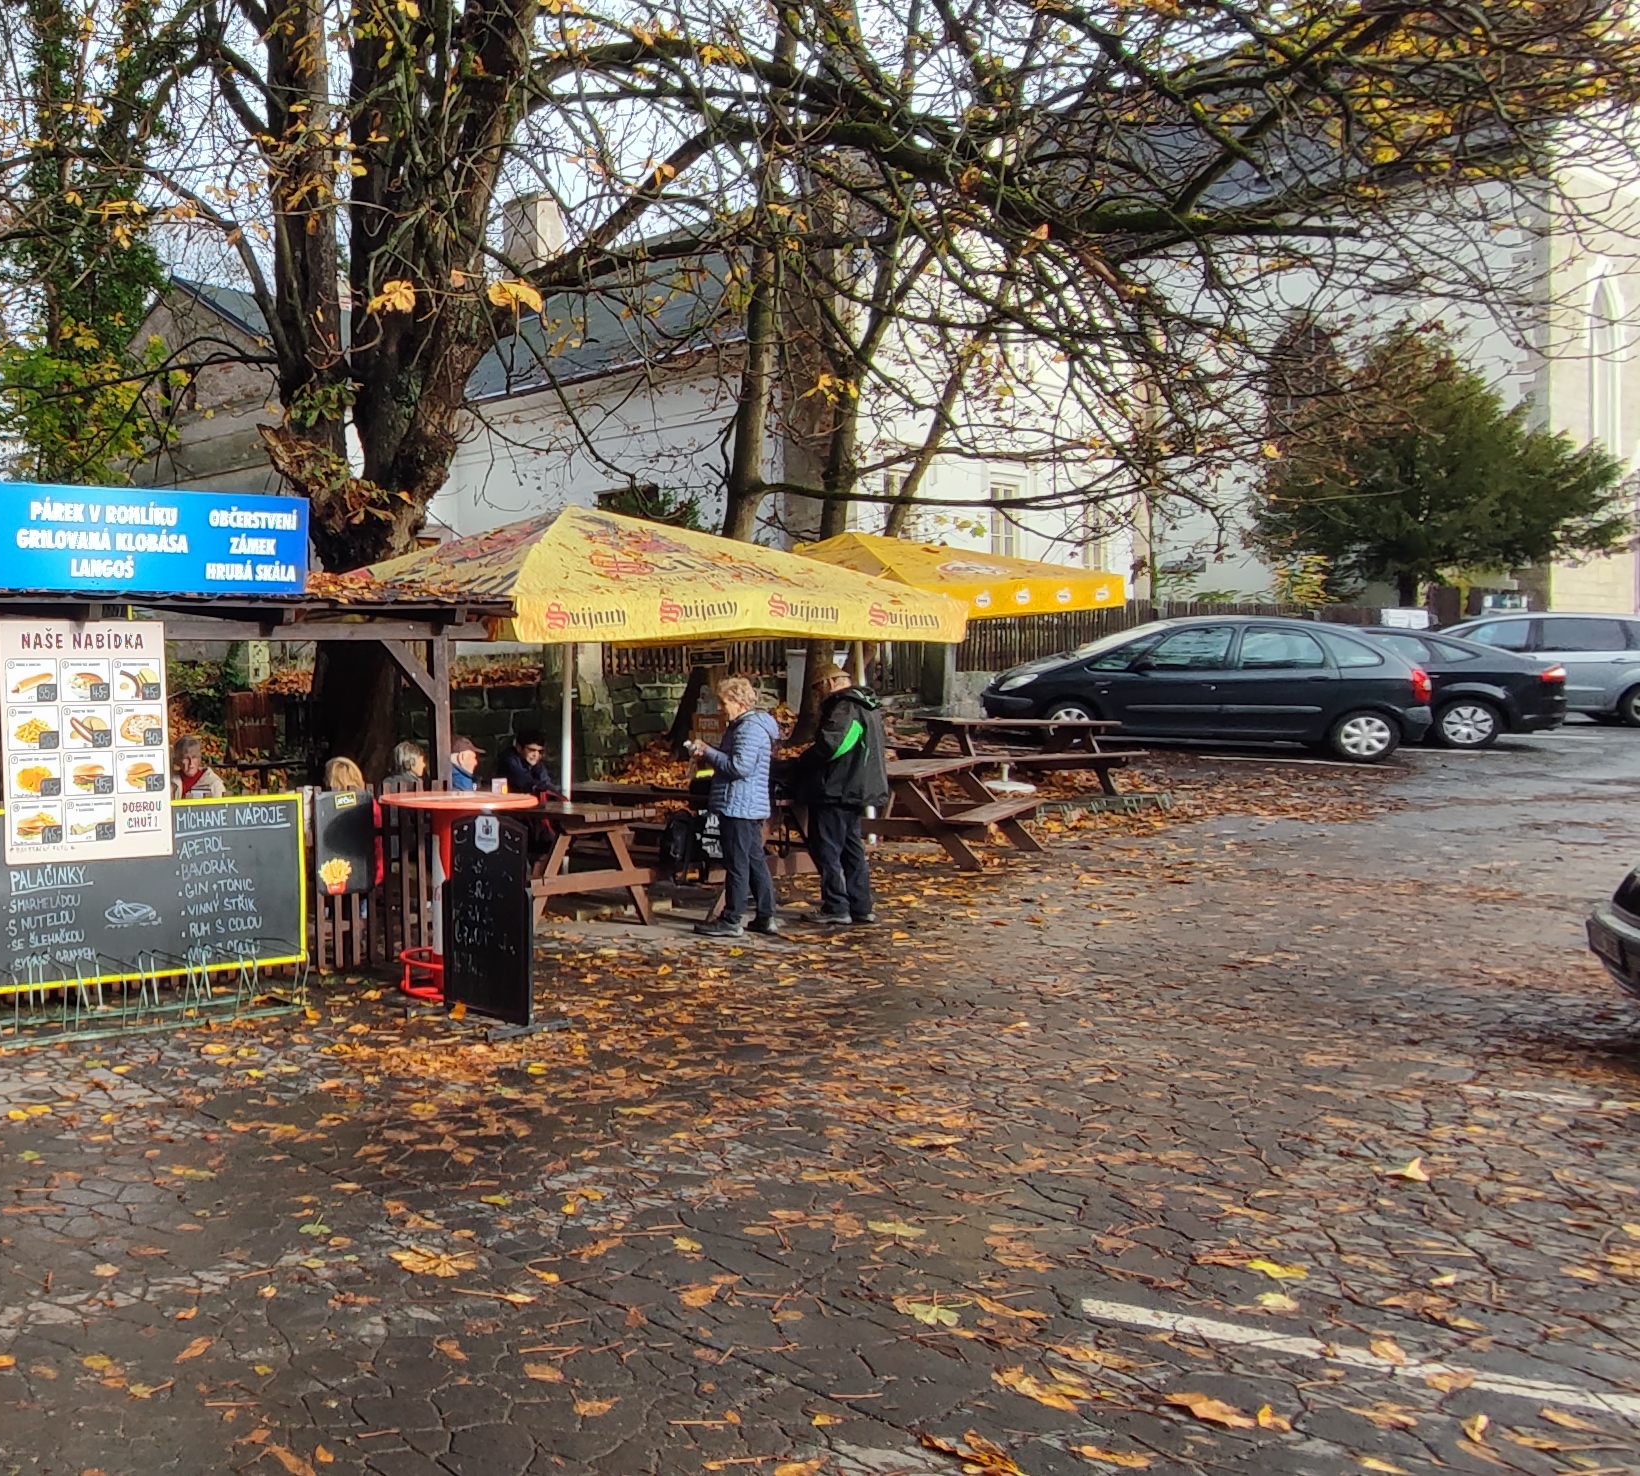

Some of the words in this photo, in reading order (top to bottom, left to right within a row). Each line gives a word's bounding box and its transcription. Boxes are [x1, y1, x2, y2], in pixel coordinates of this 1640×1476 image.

[30, 496, 85, 523] PÁREK
[89, 503, 101, 523] V
[105, 501, 178, 527] ROHLÍKU
[208, 505, 298, 531] OBČERSTVENÍ
[16, 527, 111, 551] GRILOVANÁ
[115, 529, 189, 554] KLOBÁSA
[228, 533, 277, 556] ZÁMEK
[70, 555, 135, 579] LANGOŠ
[205, 559, 253, 581] HRUBÁ
[254, 560, 297, 583] SKÁLA
[545, 601, 627, 630] Svijany
[660, 597, 738, 624] Svijany
[767, 592, 839, 623] Svijany
[868, 602, 940, 630] Svijany
[21, 628, 63, 650] NAŠE
[72, 628, 144, 650] NABÍDKA
[122, 800, 162, 813] DOBROU
[176, 803, 229, 832] MÍCHANÉ
[235, 802, 287, 826] NÁPOJE
[179, 836, 231, 860] APEROL
[10, 864, 87, 892] PALAČINKY
[181, 853, 239, 881] BAVORÁK
[184, 881, 208, 899] GIN
[187, 893, 219, 916] VINNÝ
[223, 893, 257, 912] STŘIK
[8, 919, 18, 937] S
[20, 909, 76, 931] NUTELOU
[189, 922, 210, 938] RUM
[215, 920, 225, 934] S
[229, 916, 263, 931] COLOU
[11, 938, 25, 952] SE
